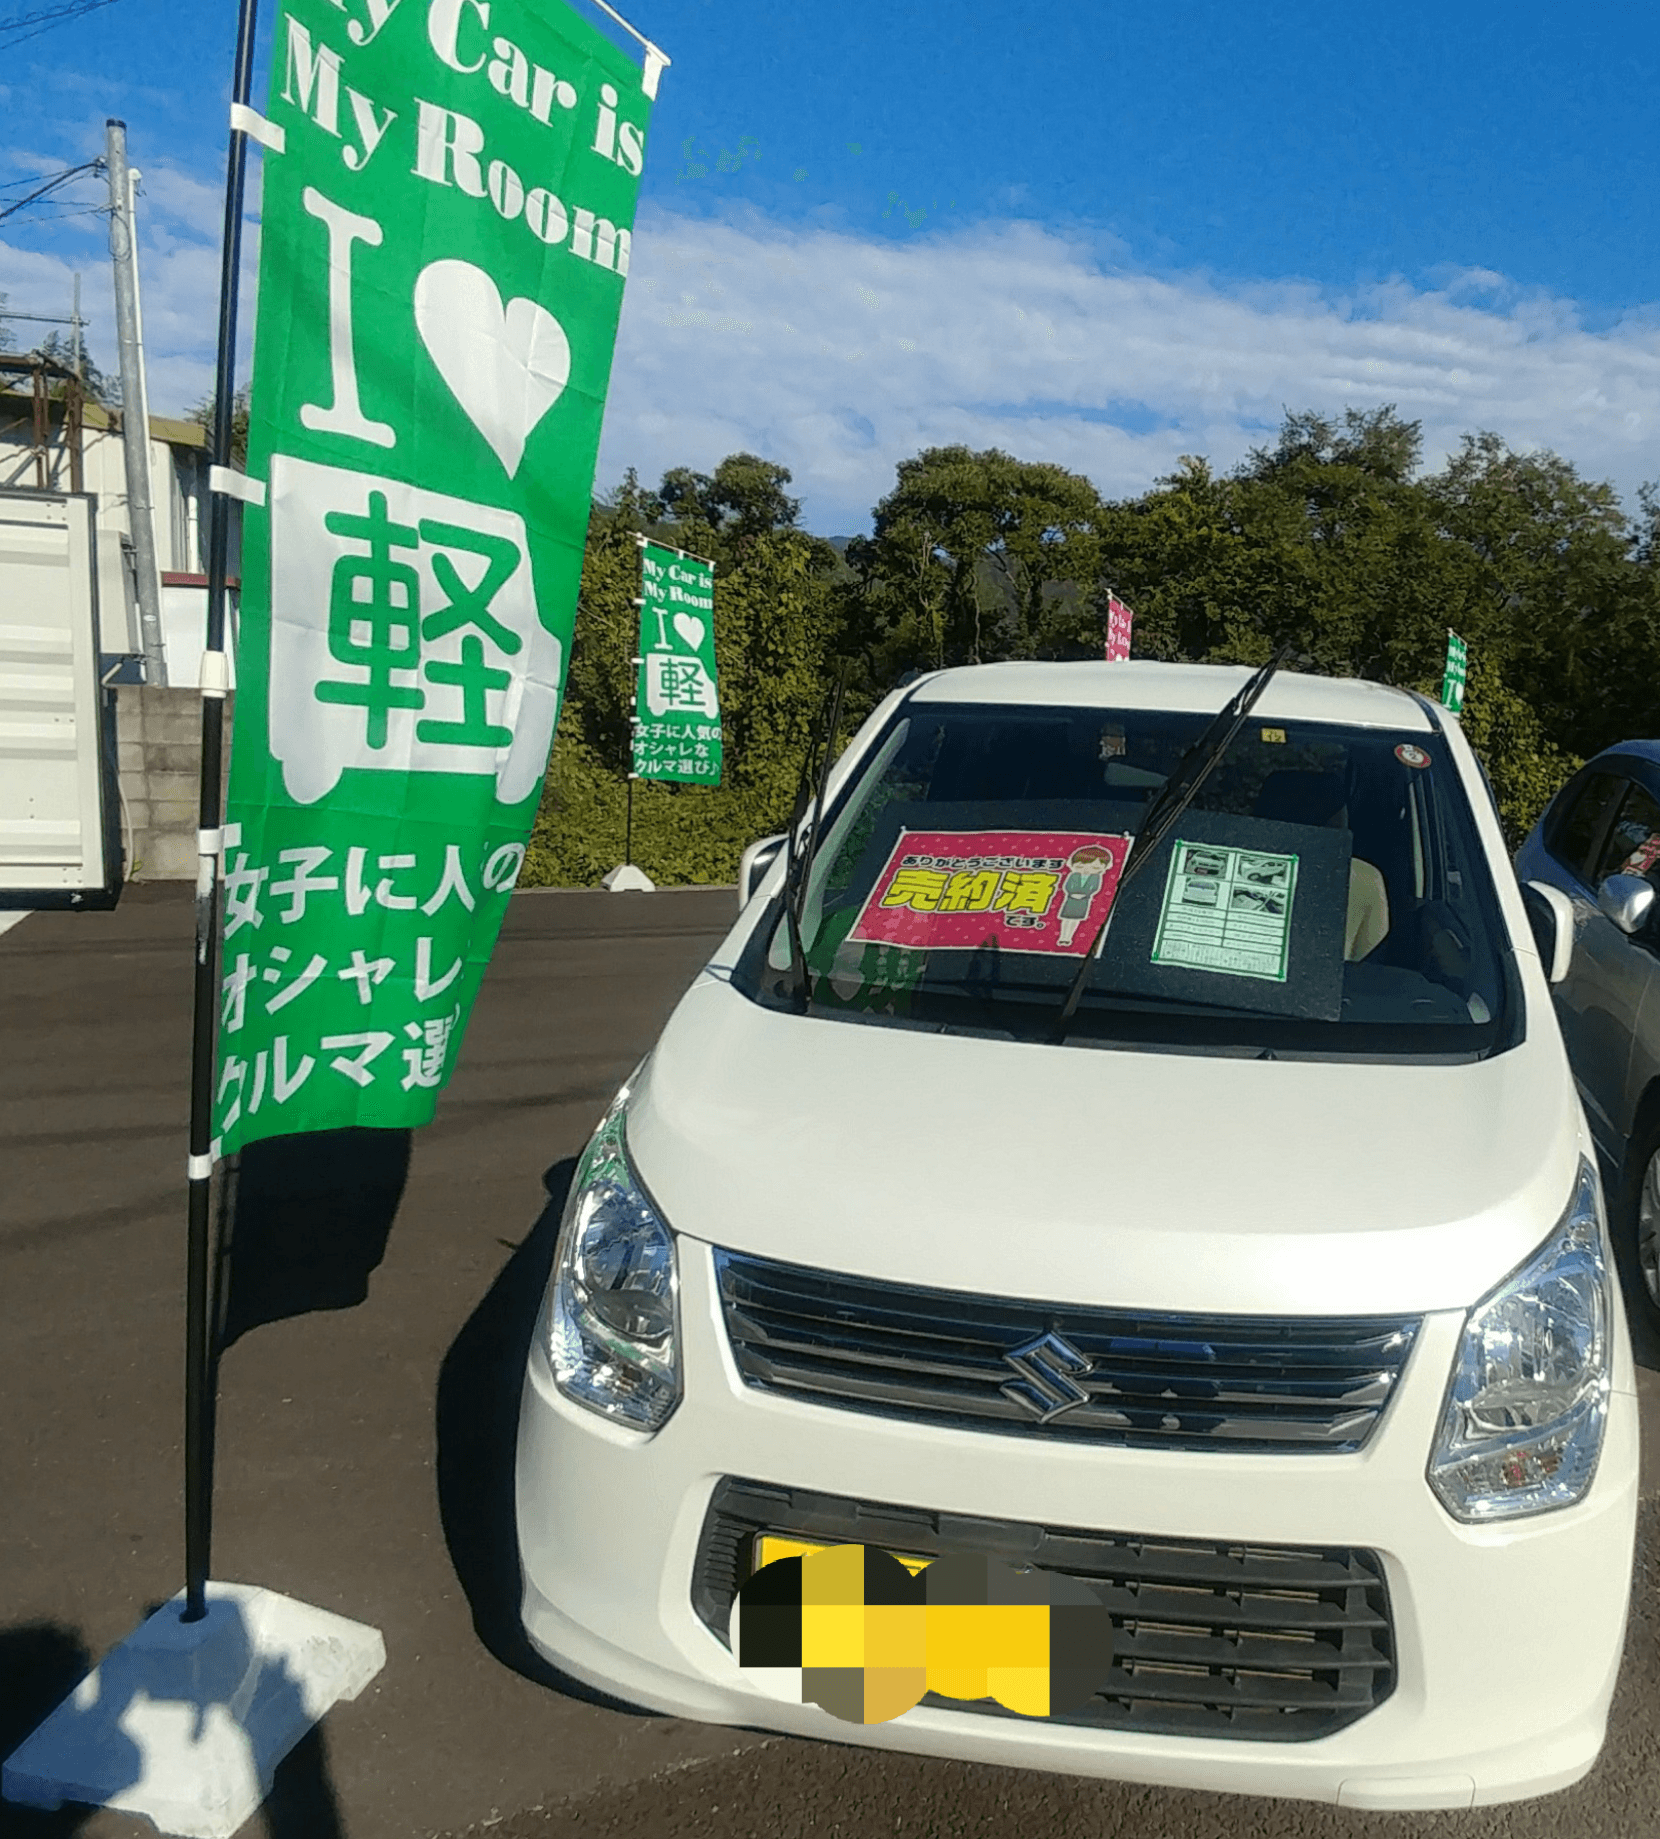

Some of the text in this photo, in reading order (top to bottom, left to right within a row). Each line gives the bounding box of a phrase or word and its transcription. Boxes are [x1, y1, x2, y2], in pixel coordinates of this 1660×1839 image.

[427, 0, 578, 128] Car
[590, 83, 645, 177] is
[280, 12, 632, 278] My Room
[300, 186, 397, 449] I
[642, 558, 714, 589] My Car is
[643, 580, 714, 609] My Room
[313, 489, 524, 751] 軽
[651, 606, 674, 651] I
[658, 657, 707, 706] 軽
[633, 722, 722, 741] 女子に人気の
[633, 740, 710, 759] オシャレな
[901, 854, 1065, 871] ありがとうございます
[223, 842, 526, 940] 女子に人の
[881, 869, 1061, 914] 売約済
